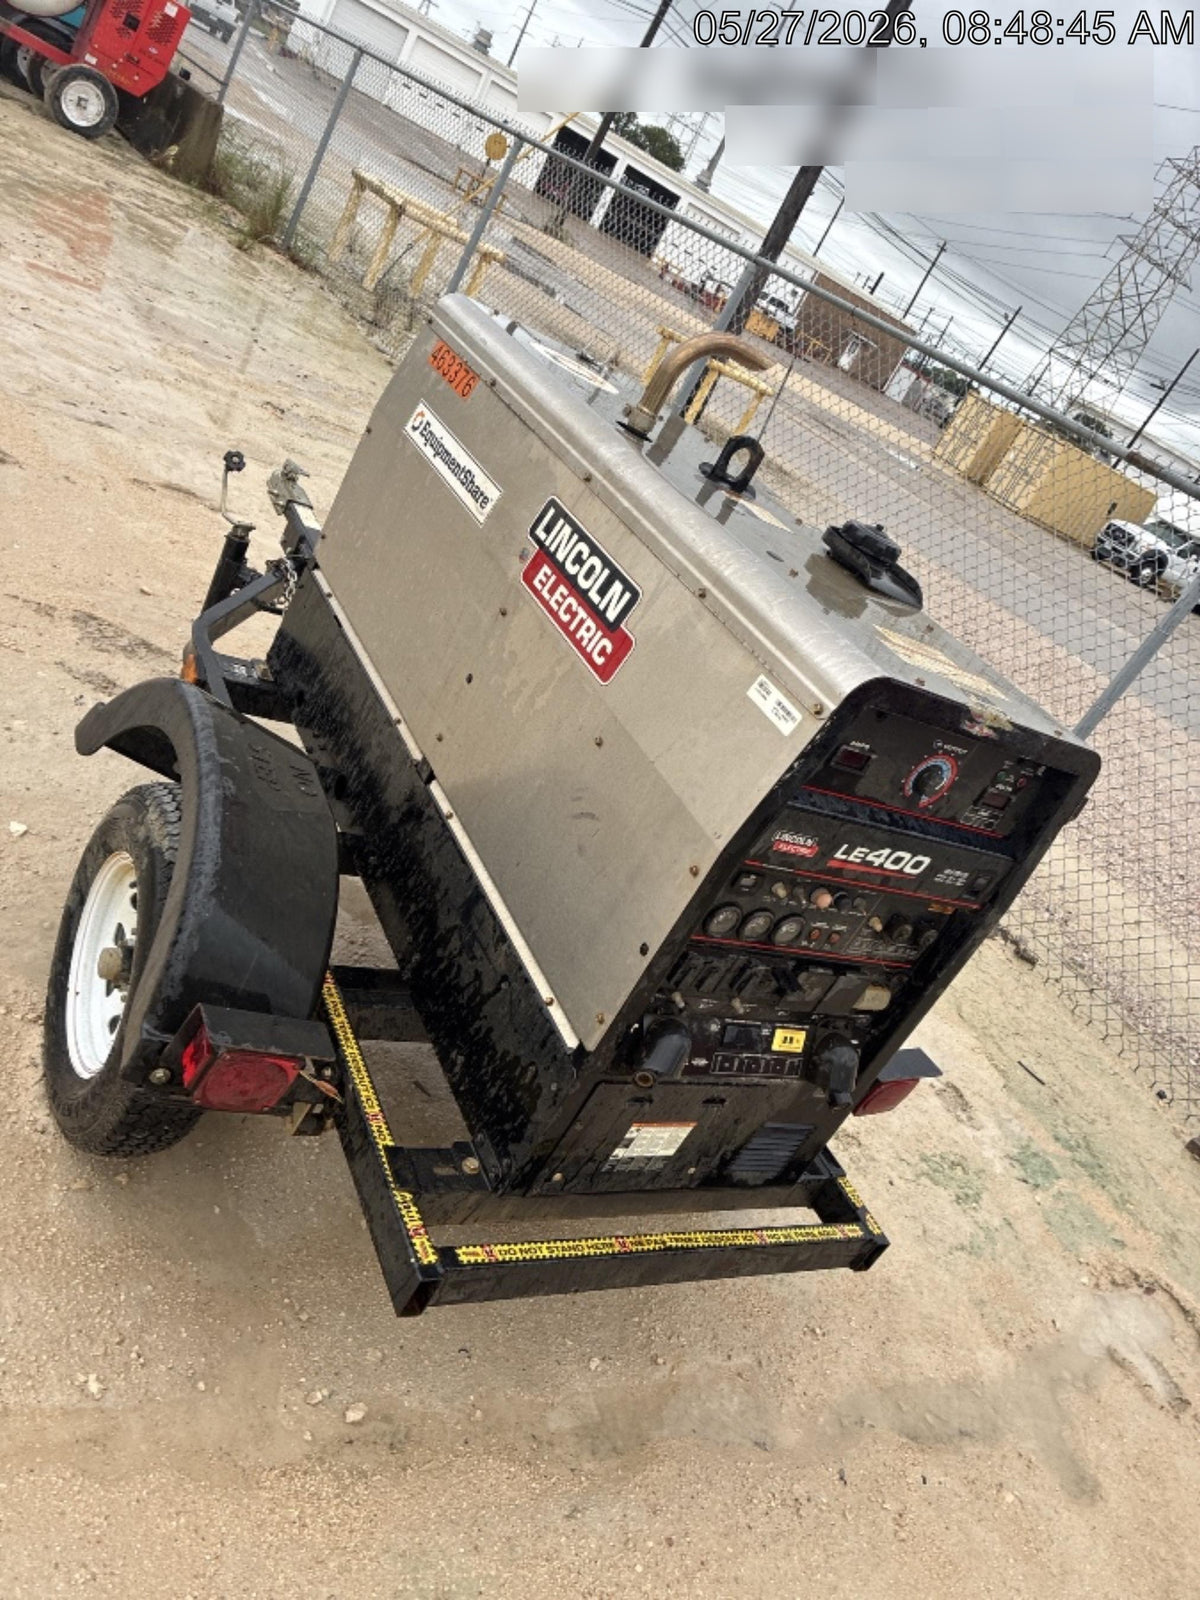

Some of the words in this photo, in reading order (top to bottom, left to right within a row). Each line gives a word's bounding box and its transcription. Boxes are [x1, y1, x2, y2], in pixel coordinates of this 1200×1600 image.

[431, 345, 474, 397] 463376
[419, 419, 491, 510] EquipmentShare
[535, 506, 632, 623] LINCOLN
[532, 563, 613, 666] ELECTRIC
[833, 844, 933, 875] LE400
[497, 1247, 516, 1256] DO
[519, 1245, 543, 1255] NOT
[545, 1242, 583, 1253] STAND
[586, 1240, 615, 1250] HERE
